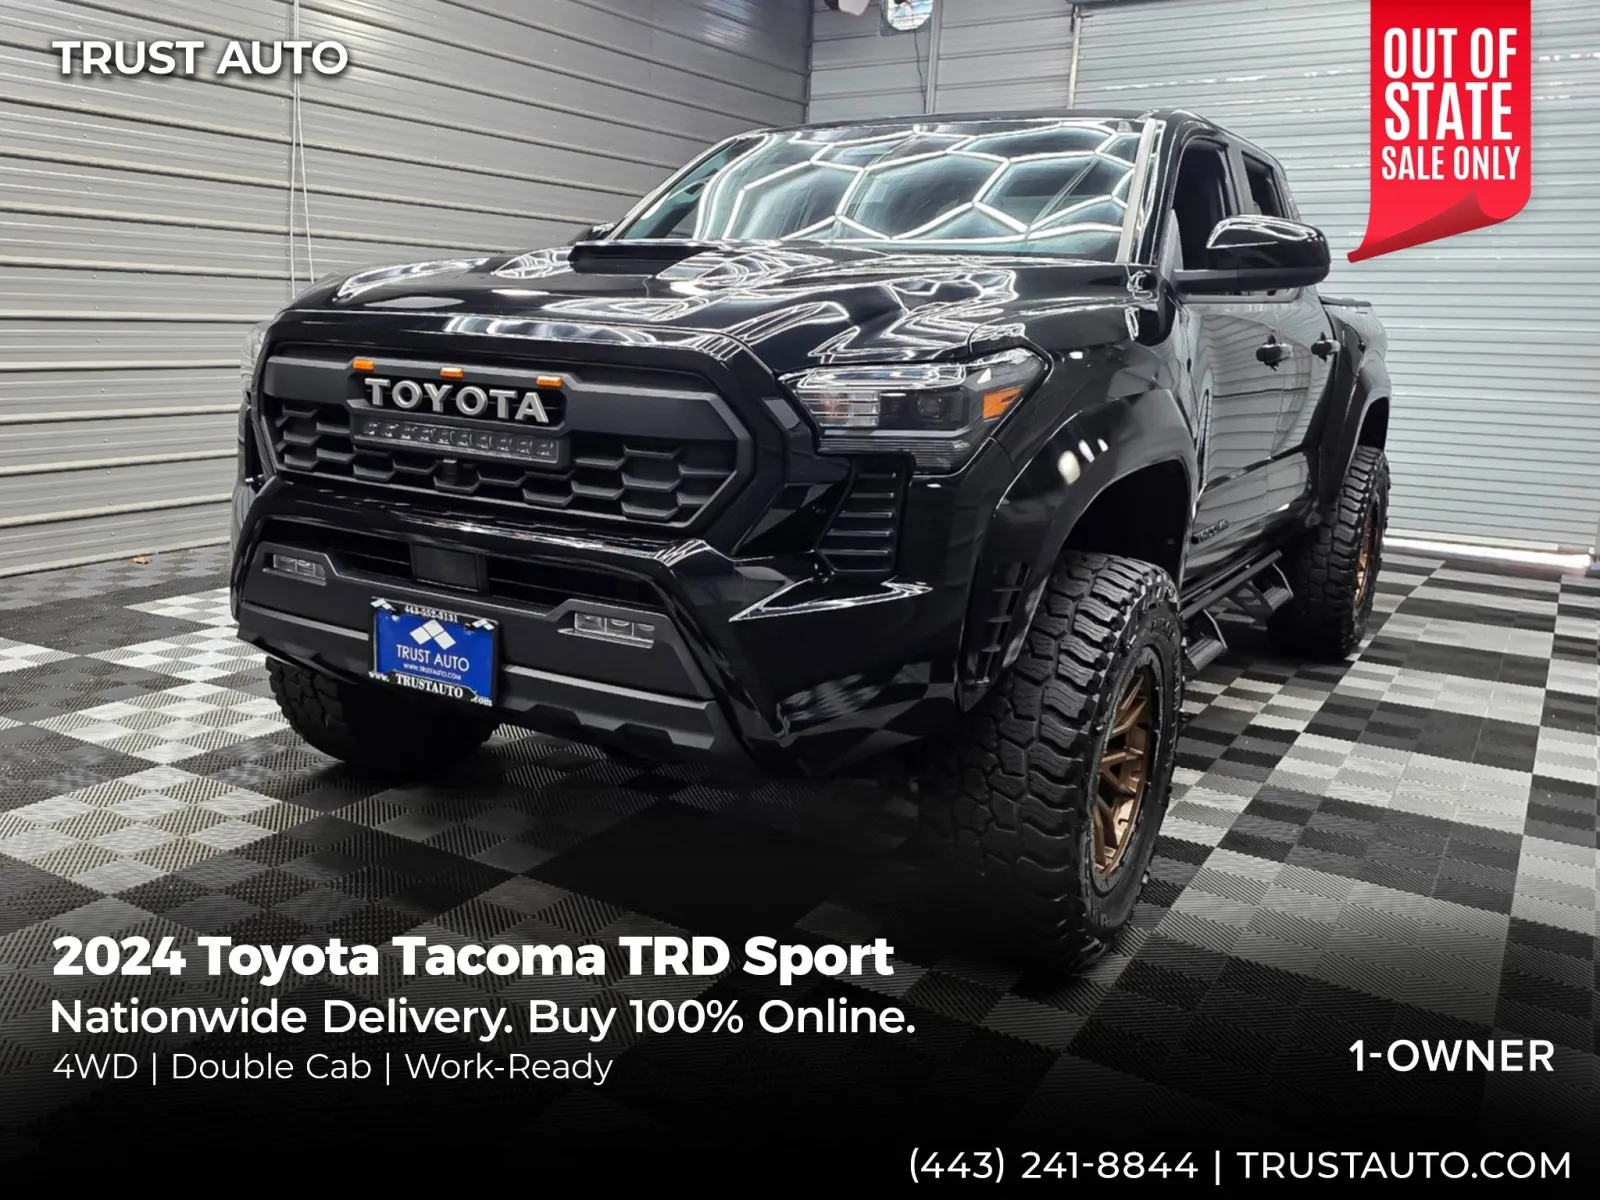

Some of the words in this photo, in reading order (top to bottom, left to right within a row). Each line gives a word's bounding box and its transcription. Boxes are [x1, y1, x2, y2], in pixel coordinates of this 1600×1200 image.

[364, 377, 549, 424] TOYOTA
[396, 643, 431, 664] TRUST
[433, 652, 470, 672] AUTO
[395, 672, 464, 699] TRUSTAUTO
